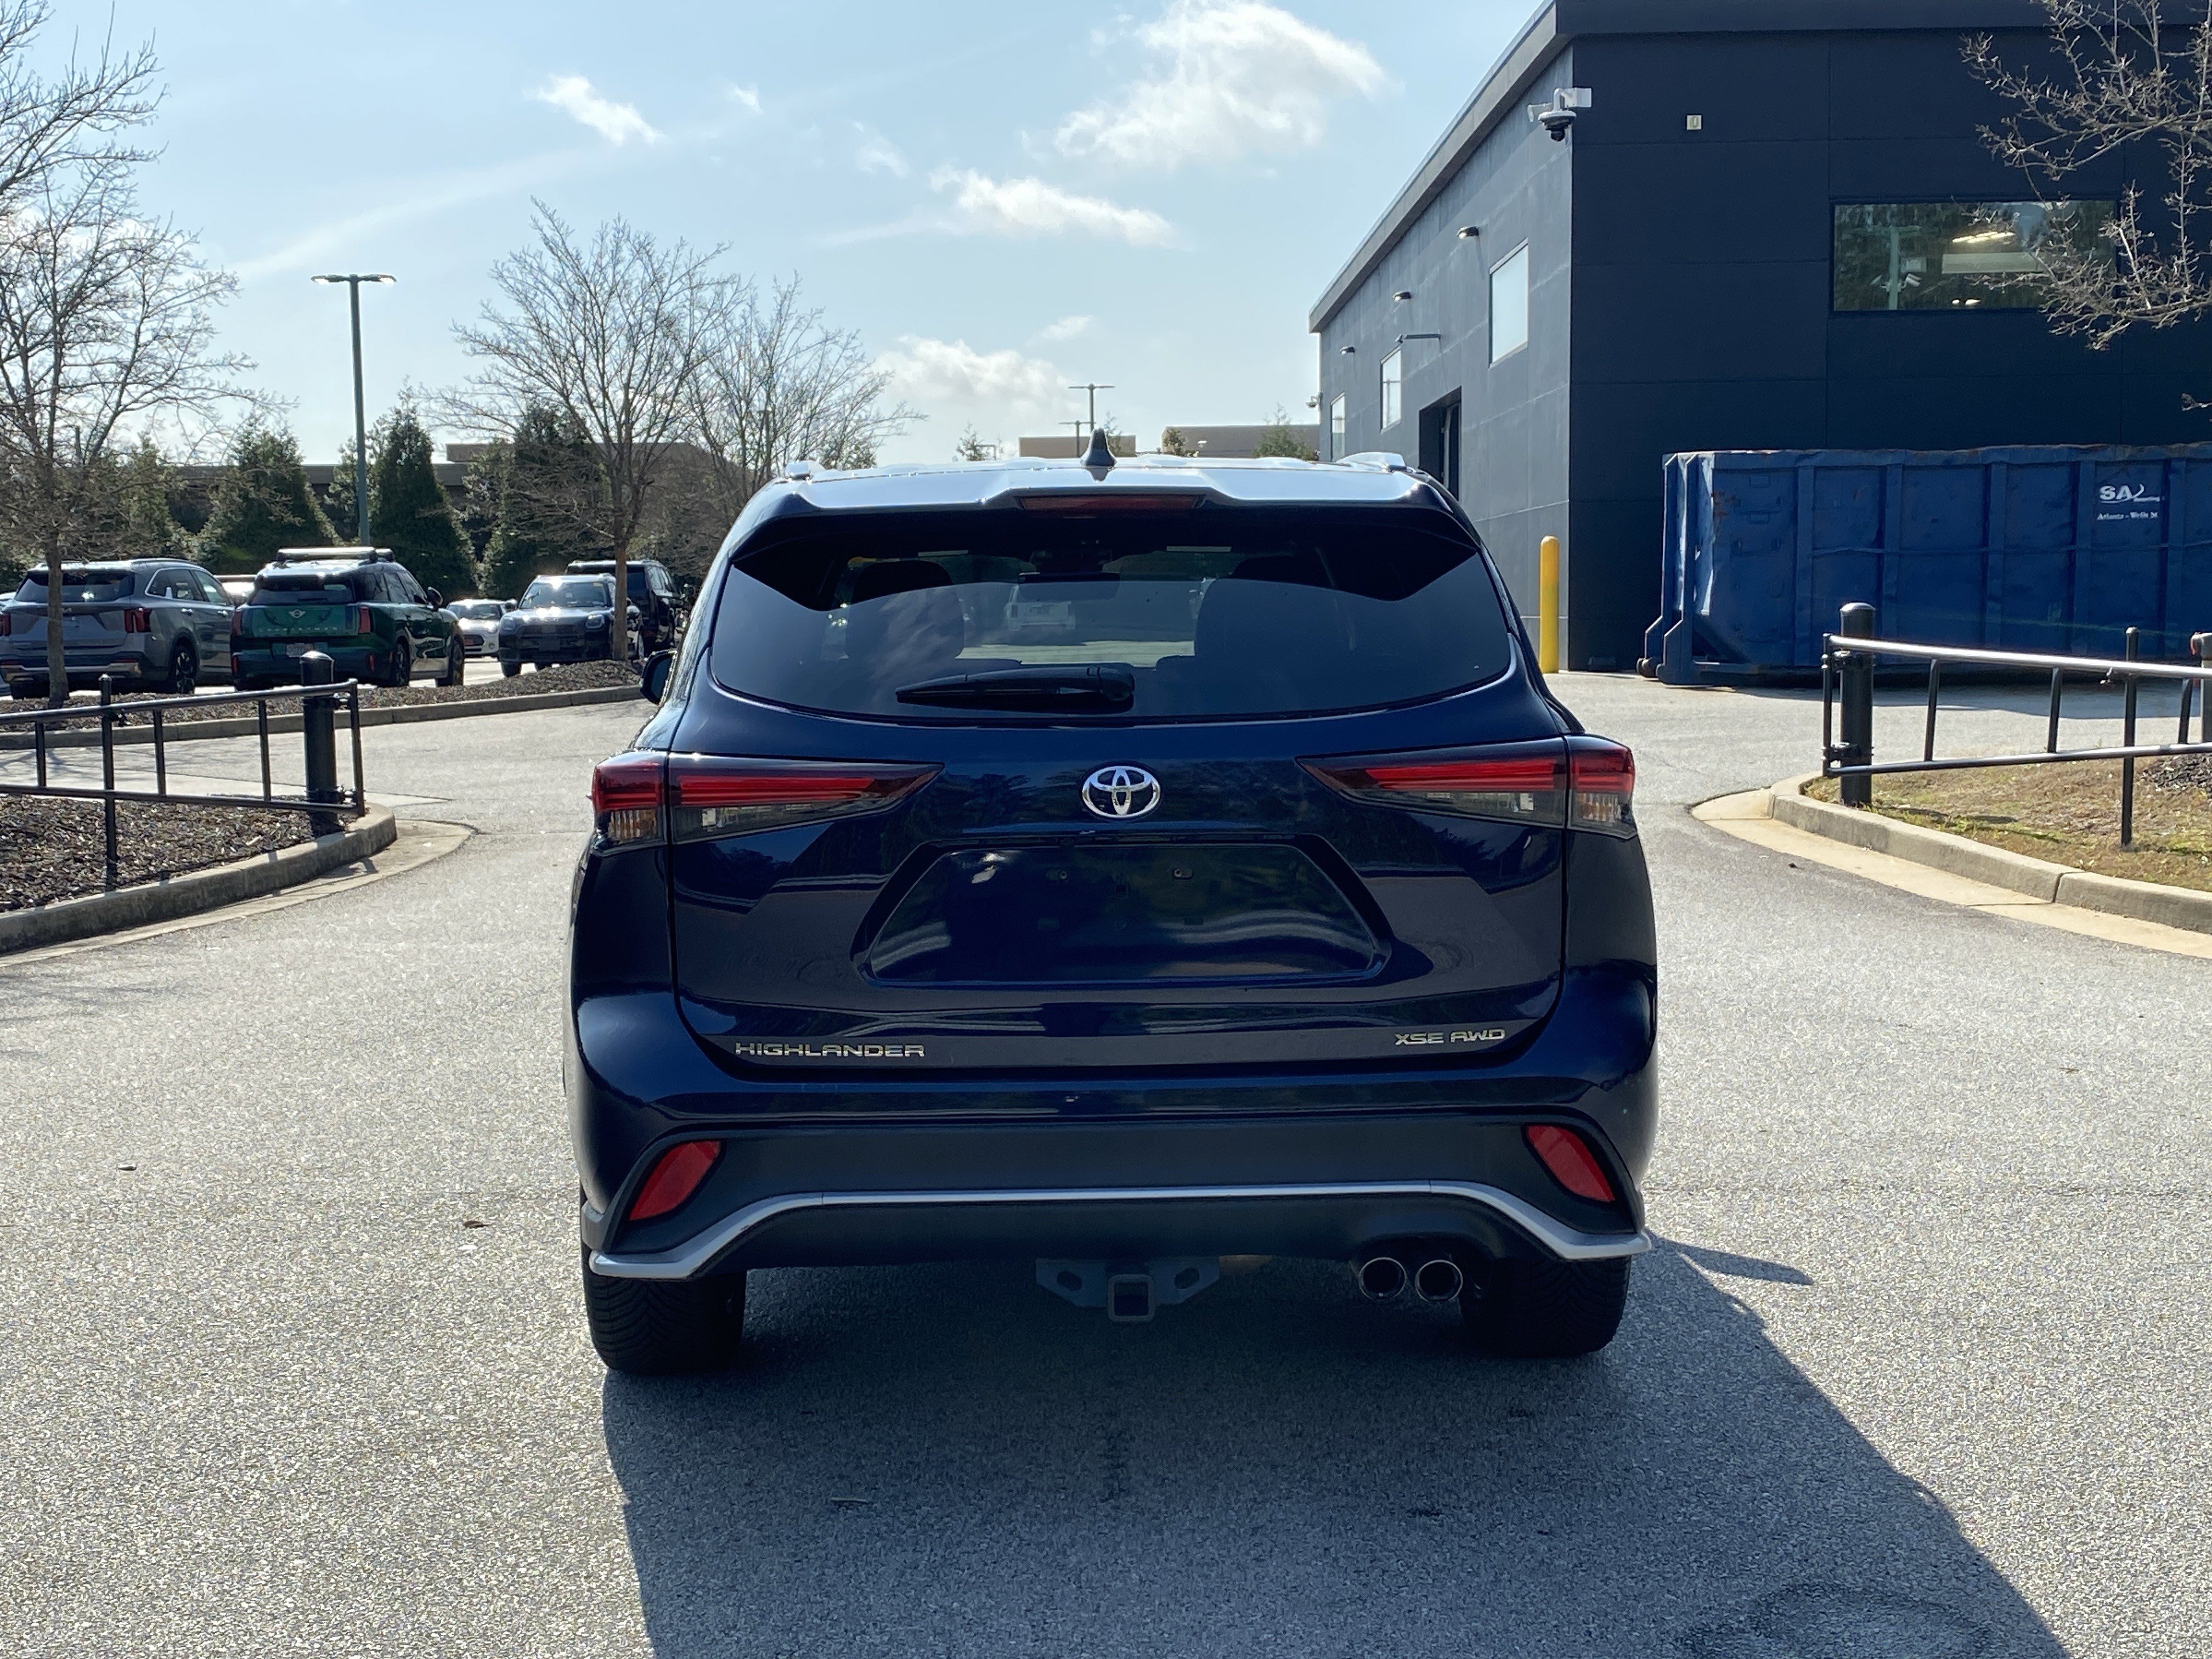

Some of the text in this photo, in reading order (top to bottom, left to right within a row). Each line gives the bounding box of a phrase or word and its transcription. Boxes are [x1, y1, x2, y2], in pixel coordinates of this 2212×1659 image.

[1395, 1028, 1506, 1045] XSE AWD
[735, 1042, 925, 1057] HIGHLANDER
